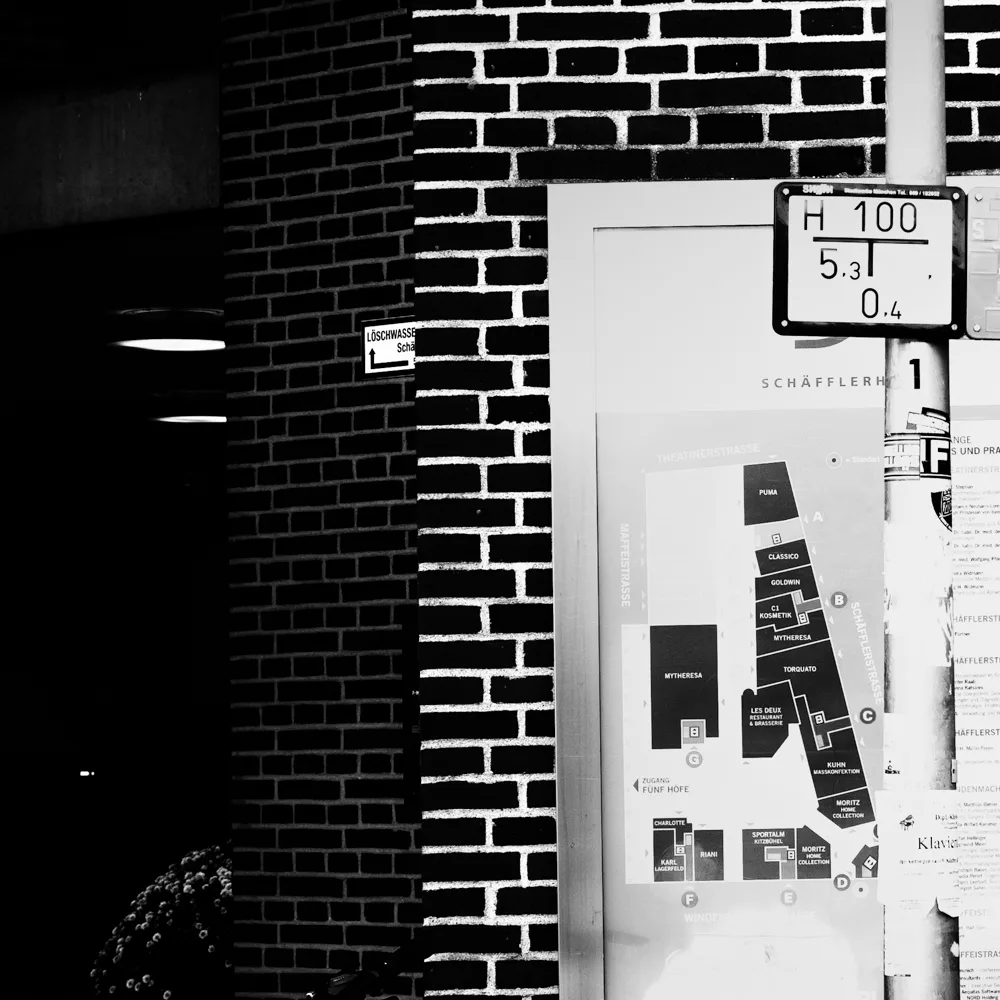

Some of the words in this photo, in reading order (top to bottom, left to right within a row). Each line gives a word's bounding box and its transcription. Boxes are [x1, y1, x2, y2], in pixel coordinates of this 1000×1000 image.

[803, 200, 824, 231] H
[853, 201, 917, 233] 100
[972, 219, 985, 238] S
[861, 288, 902, 320] 0,4
[909, 358, 921, 389] 1
[656, 443, 761, 463] THEATINERSTRASSE
[960, 447, 981, 455] UND
[759, 488, 778, 496] PUMA
[812, 511, 824, 522] A
[620, 523, 631, 608] MAFFEISTRASSE
[770, 578, 801, 586] GOLDWIN
[834, 595, 845, 605] B
[773, 634, 812, 642] MYTHERESA
[783, 665, 817, 673] TORQUATO
[664, 672, 703, 680] MYTHERESA
[863, 710, 874, 721] C
[689, 754, 700, 766] G
[813, 768, 861, 776] MASSKONFEKTION
[642, 785, 664, 794] FÜNF
[667, 785, 690, 793] HÖFE
[836, 799, 860, 807] MORITZ
[654, 819, 686, 827] CHARLOTTE
[838, 878, 846, 888] D
[685, 895, 695, 905] F
[785, 892, 793, 902] E
